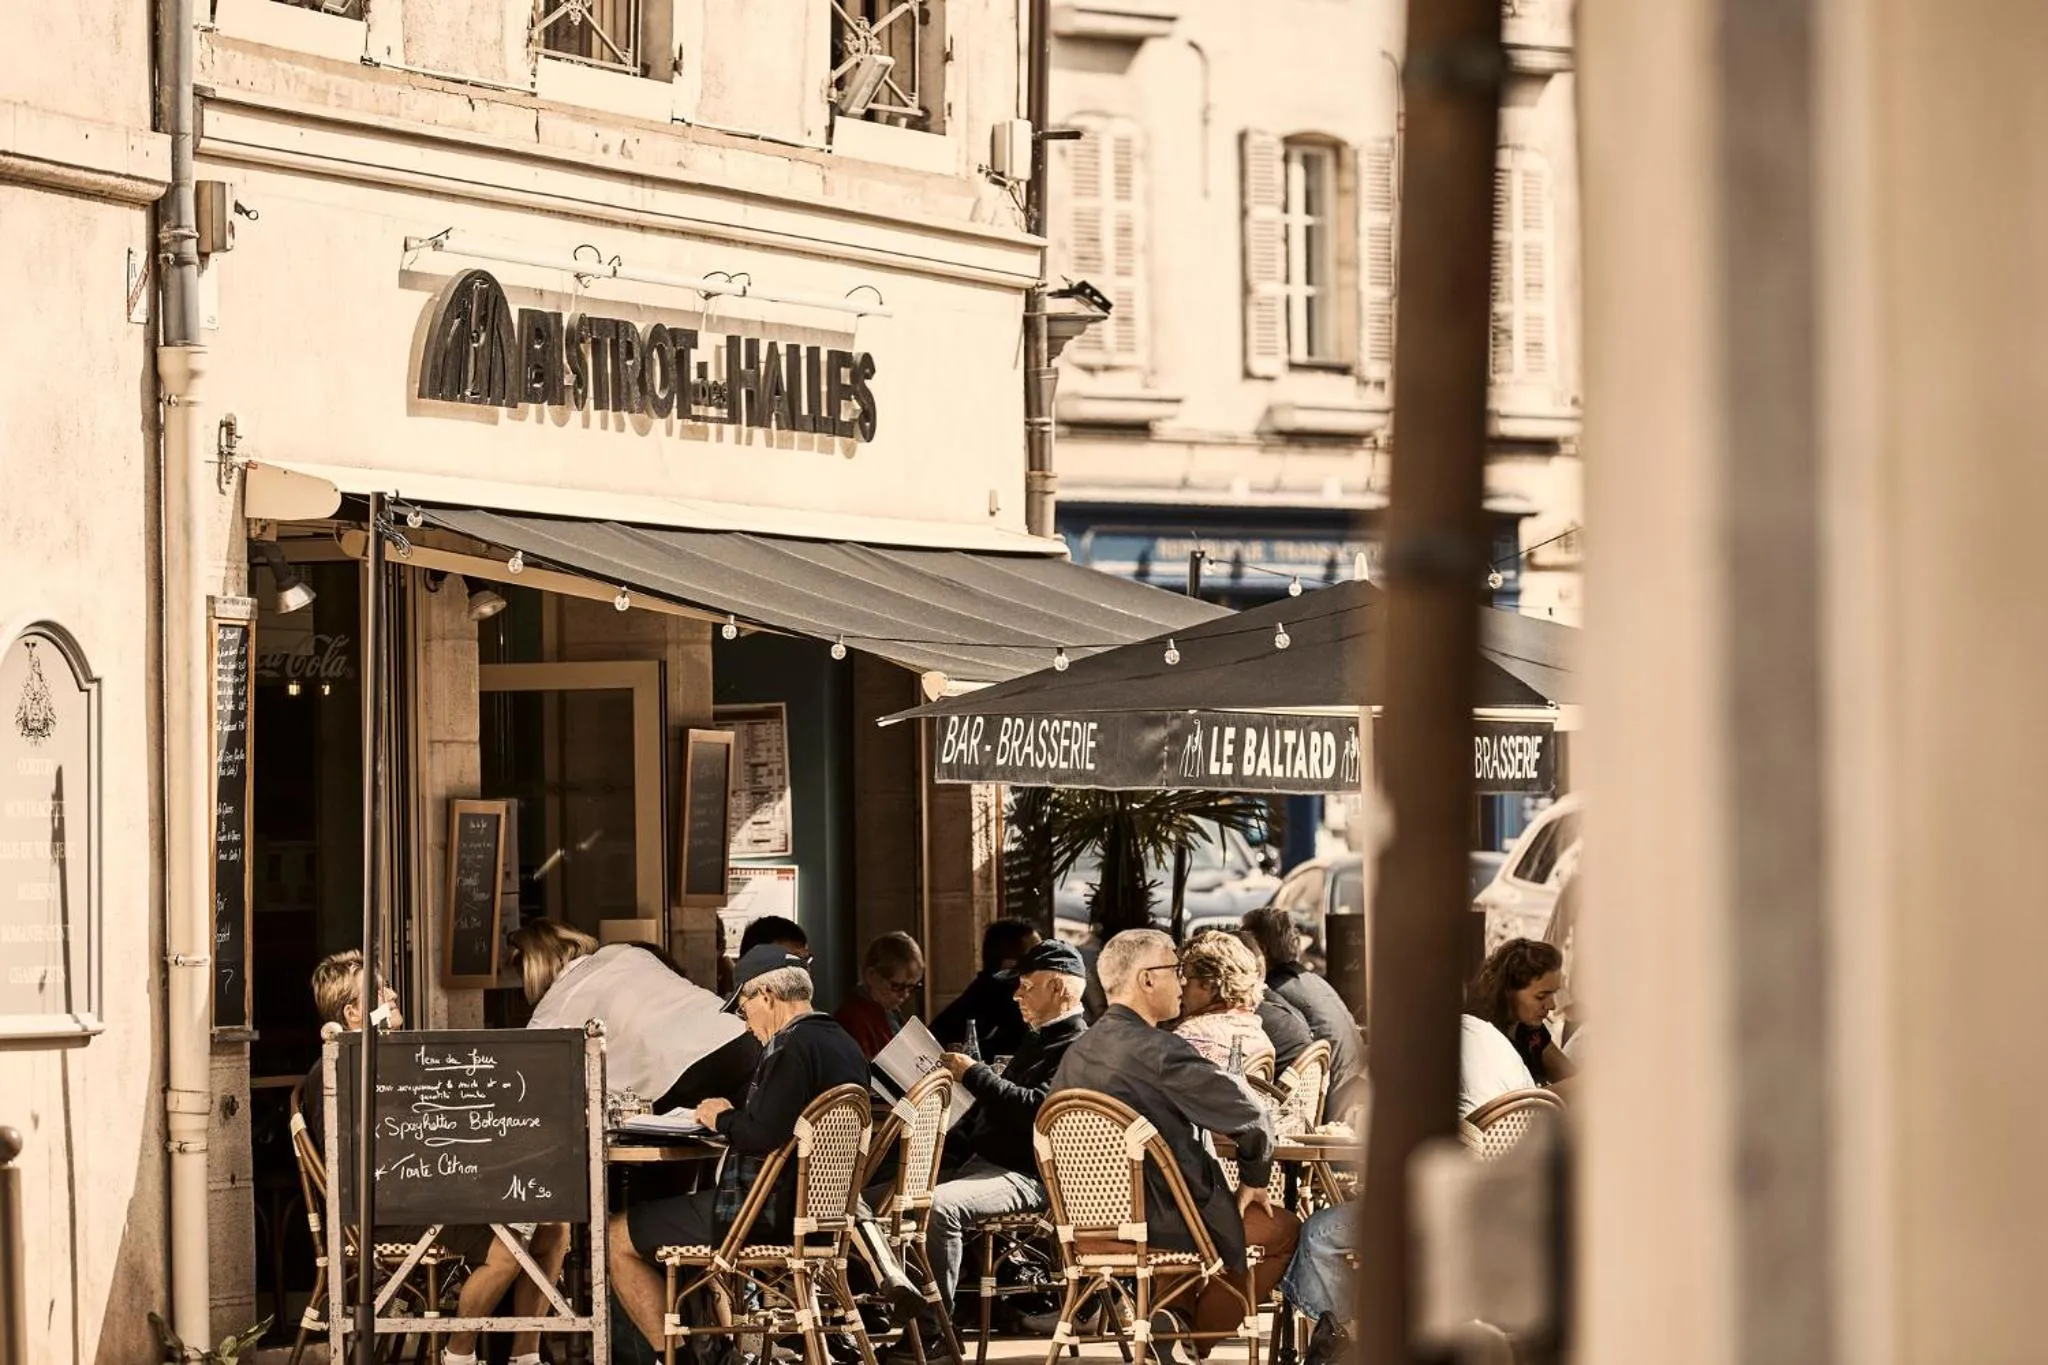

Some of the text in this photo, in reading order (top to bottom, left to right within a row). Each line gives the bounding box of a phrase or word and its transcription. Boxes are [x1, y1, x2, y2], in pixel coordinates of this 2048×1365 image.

[518, 308, 698, 420] BISTROT
[726, 334, 877, 444] HALLES
[942, 715, 984, 765] BAR
[996, 717, 1098, 770] BRASSERIE
[1208, 725, 1336, 779] LE BALTARD
[1474, 734, 1543, 779] BRASSERIE
[415, 1045, 440, 1066] Menu
[391, 1152, 478, 1180] Tarte Citron
